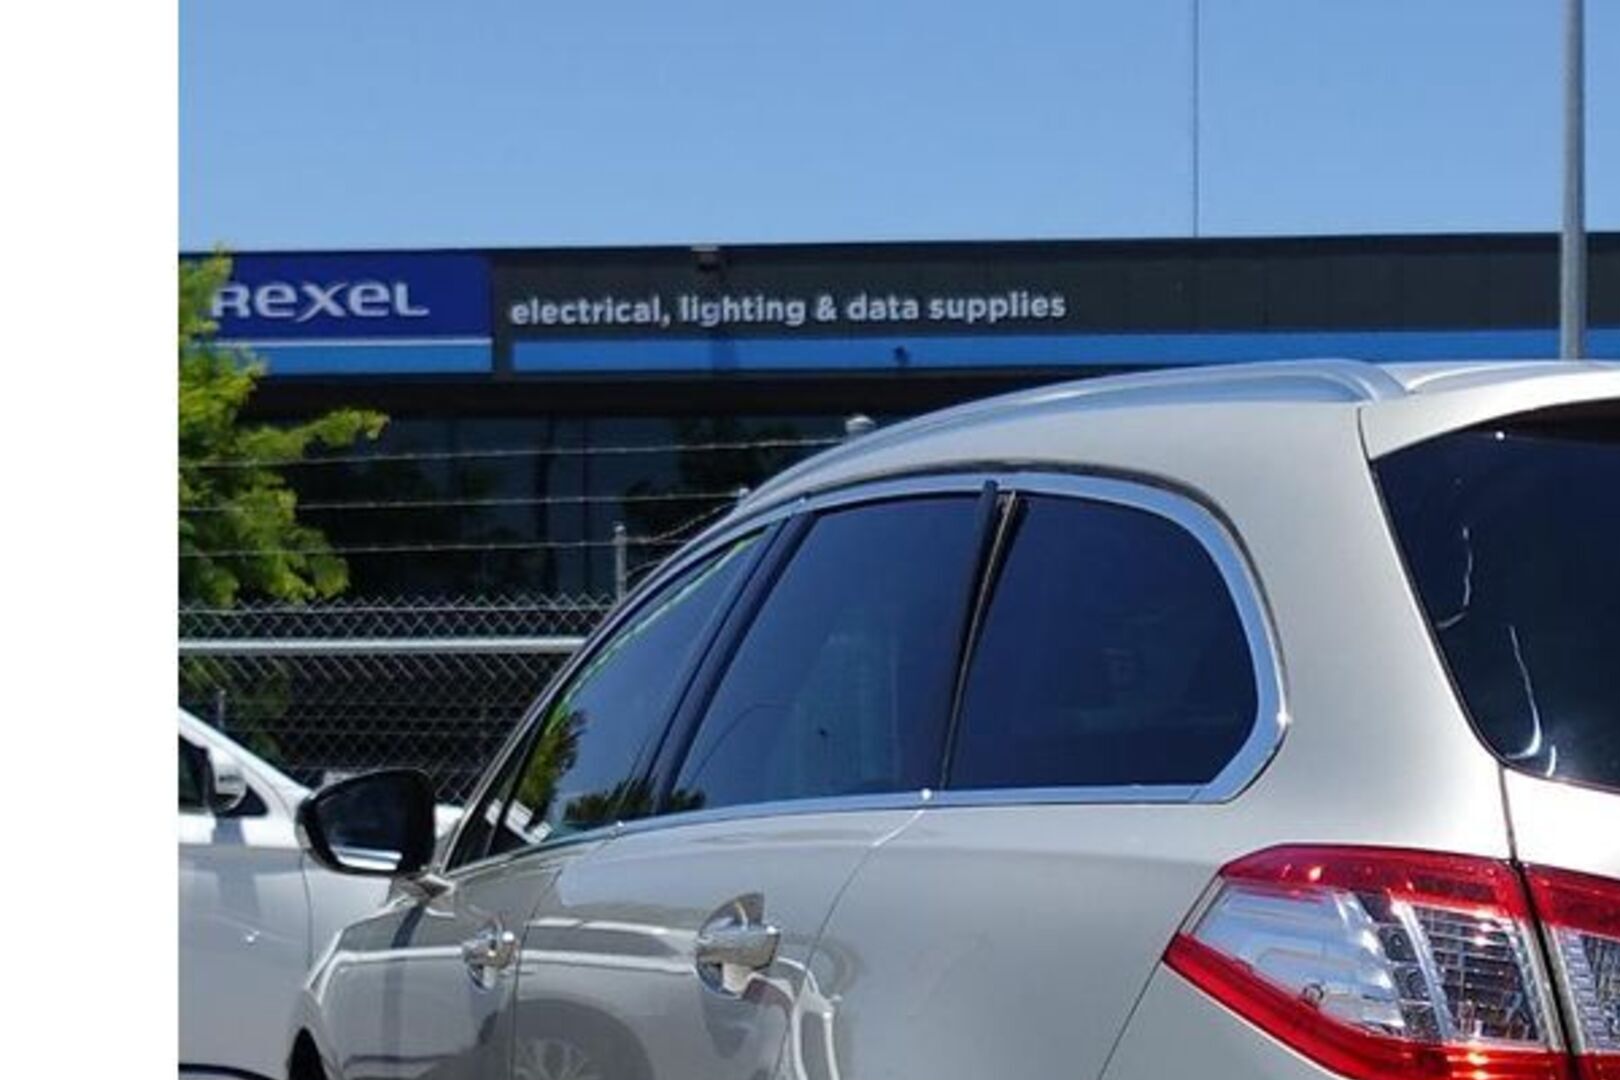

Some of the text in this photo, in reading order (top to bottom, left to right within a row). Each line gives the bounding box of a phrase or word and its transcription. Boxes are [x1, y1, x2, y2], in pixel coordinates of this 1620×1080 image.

[510, 291, 1067, 327] electrical, lighting & data supplies
